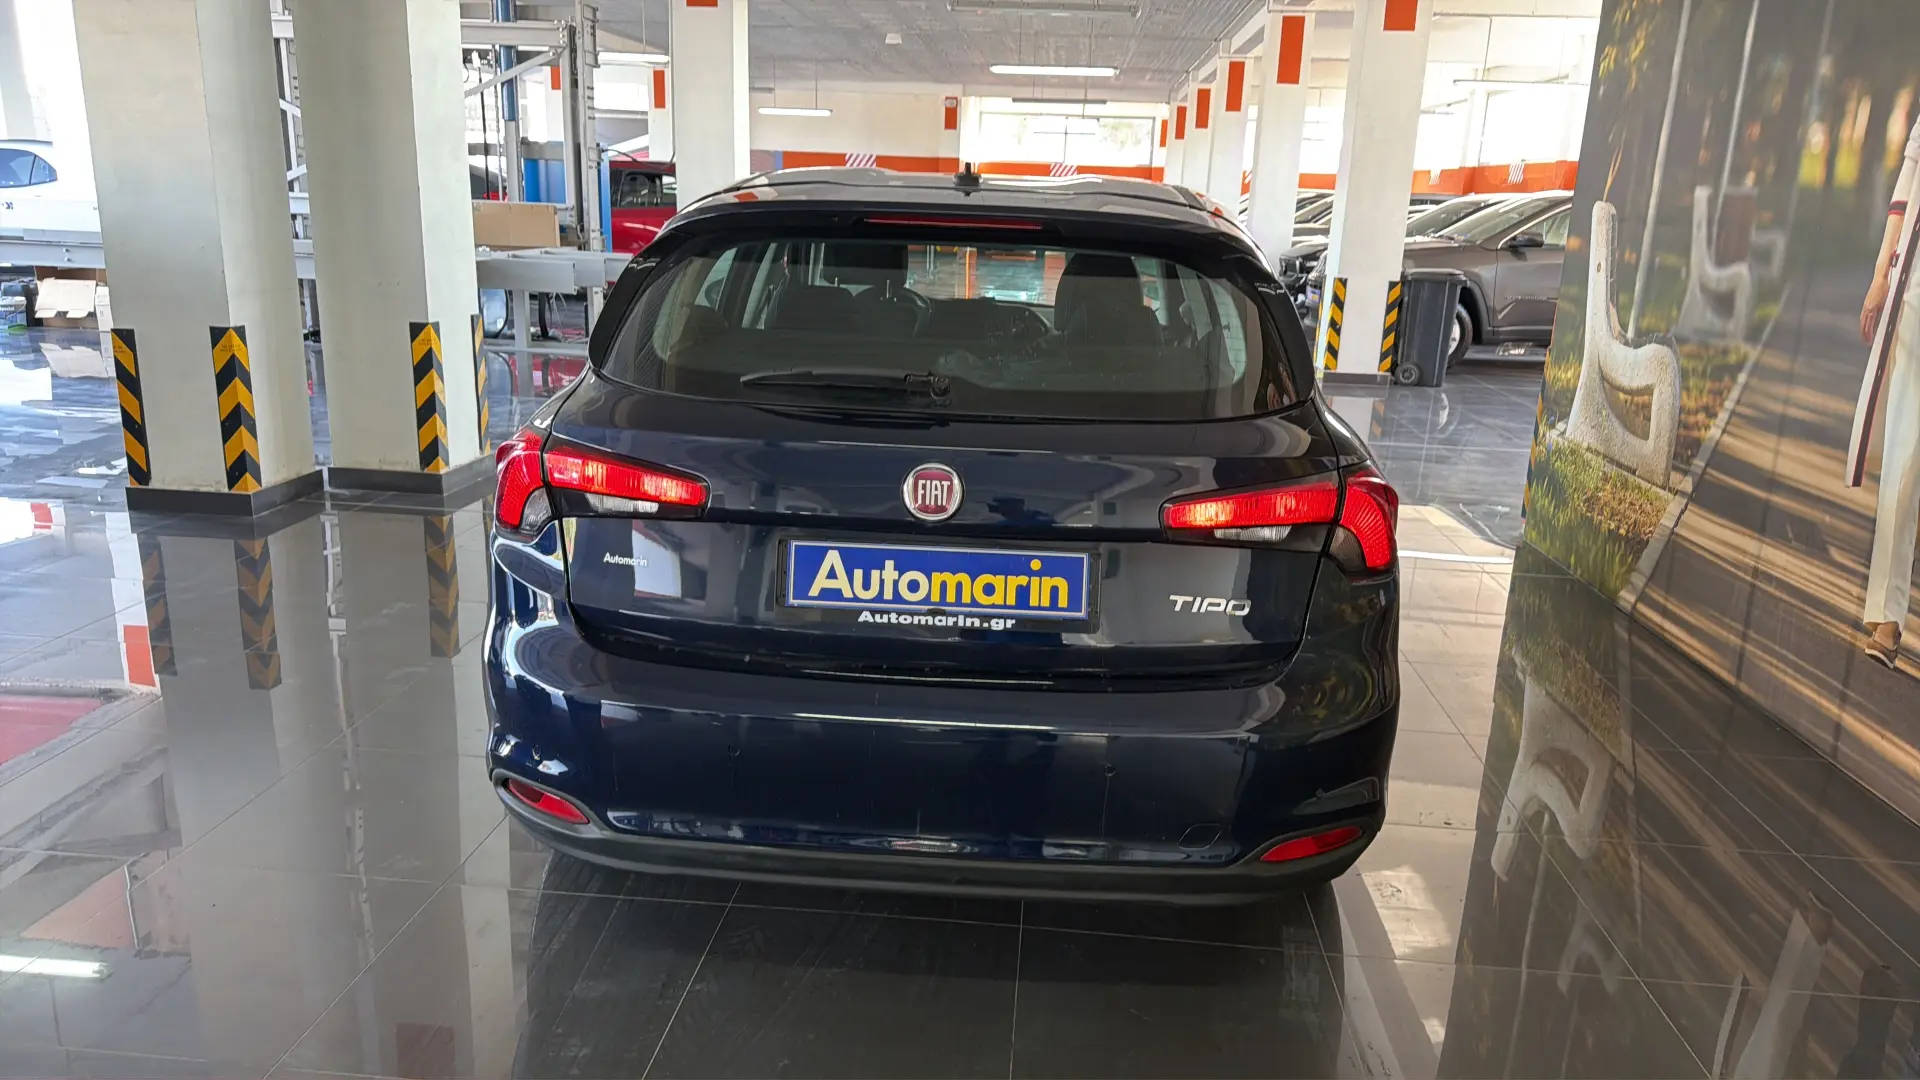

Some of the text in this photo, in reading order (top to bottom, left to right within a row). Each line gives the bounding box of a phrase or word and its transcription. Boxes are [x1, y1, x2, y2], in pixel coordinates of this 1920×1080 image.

[917, 479, 951, 506] FIAT
[603, 552, 647, 566] Automarin
[808, 549, 1069, 608] Automarin
[1169, 594, 1252, 616] TIPO
[858, 610, 1016, 630] Automarin.gr
